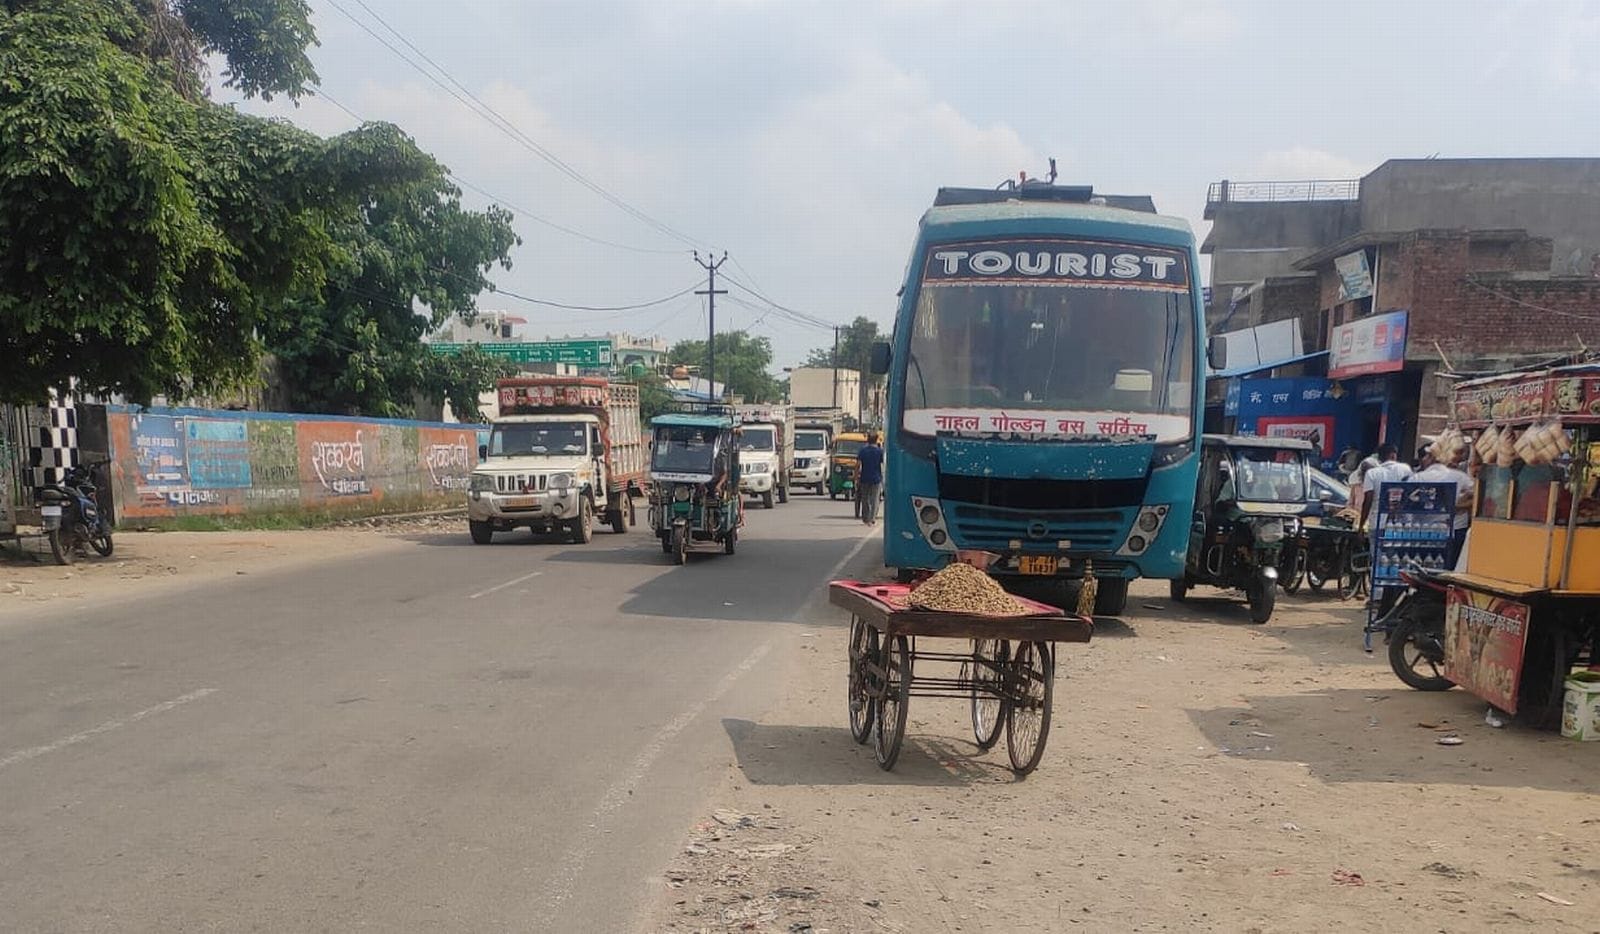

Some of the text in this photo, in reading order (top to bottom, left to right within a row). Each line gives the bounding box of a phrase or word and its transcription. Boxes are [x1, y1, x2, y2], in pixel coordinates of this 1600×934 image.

[935, 250, 1176, 279] TOURIST
[934, 411, 1148, 436] नाहल गोल्डन बस सर्विस
